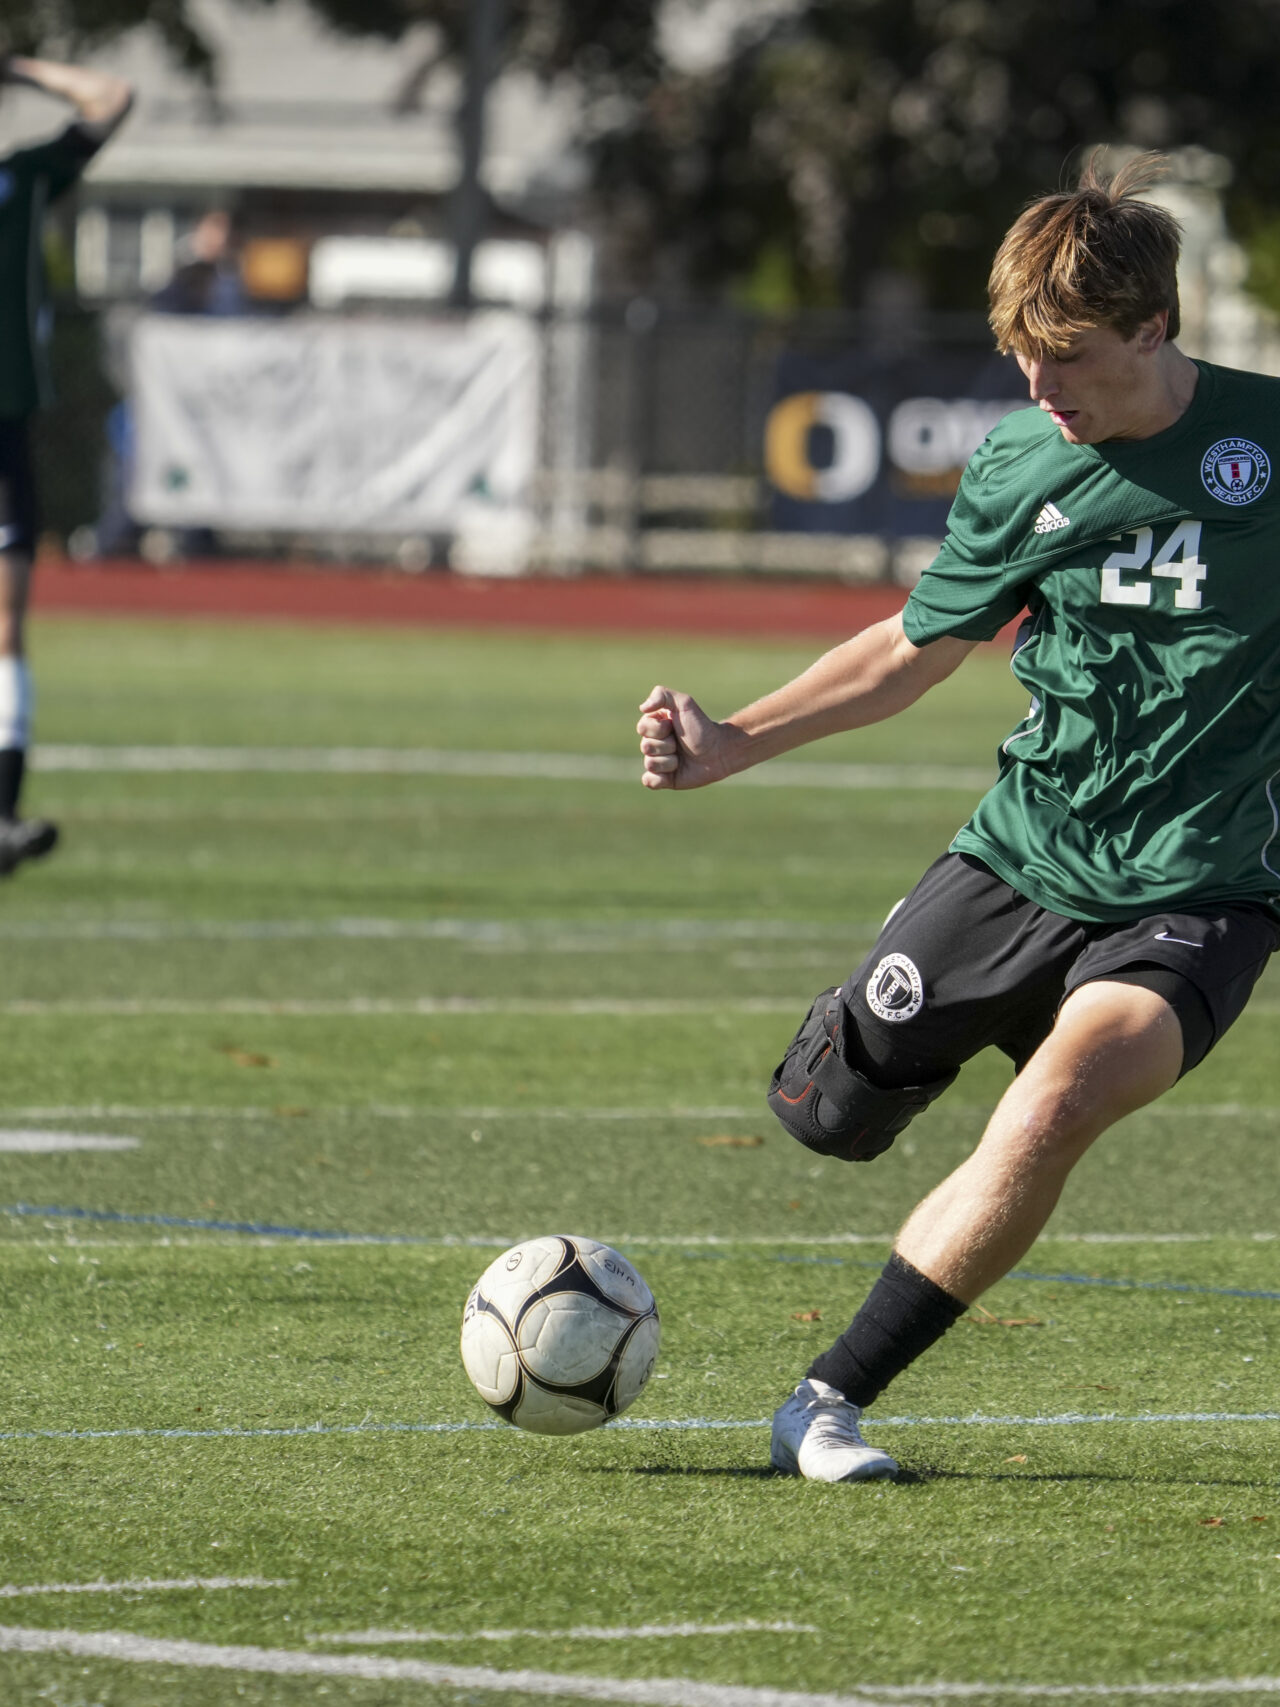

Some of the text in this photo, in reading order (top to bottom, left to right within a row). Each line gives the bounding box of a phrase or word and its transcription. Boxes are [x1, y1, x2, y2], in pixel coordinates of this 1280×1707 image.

[1204, 441, 1267, 473] WESTHAMPTON
[1213, 484, 1264, 503] BEACH F.C.
[1034, 516, 1071, 534] adidas
[1100, 519, 1207, 609] 24
[887, 1011, 905, 1020] F.C.
